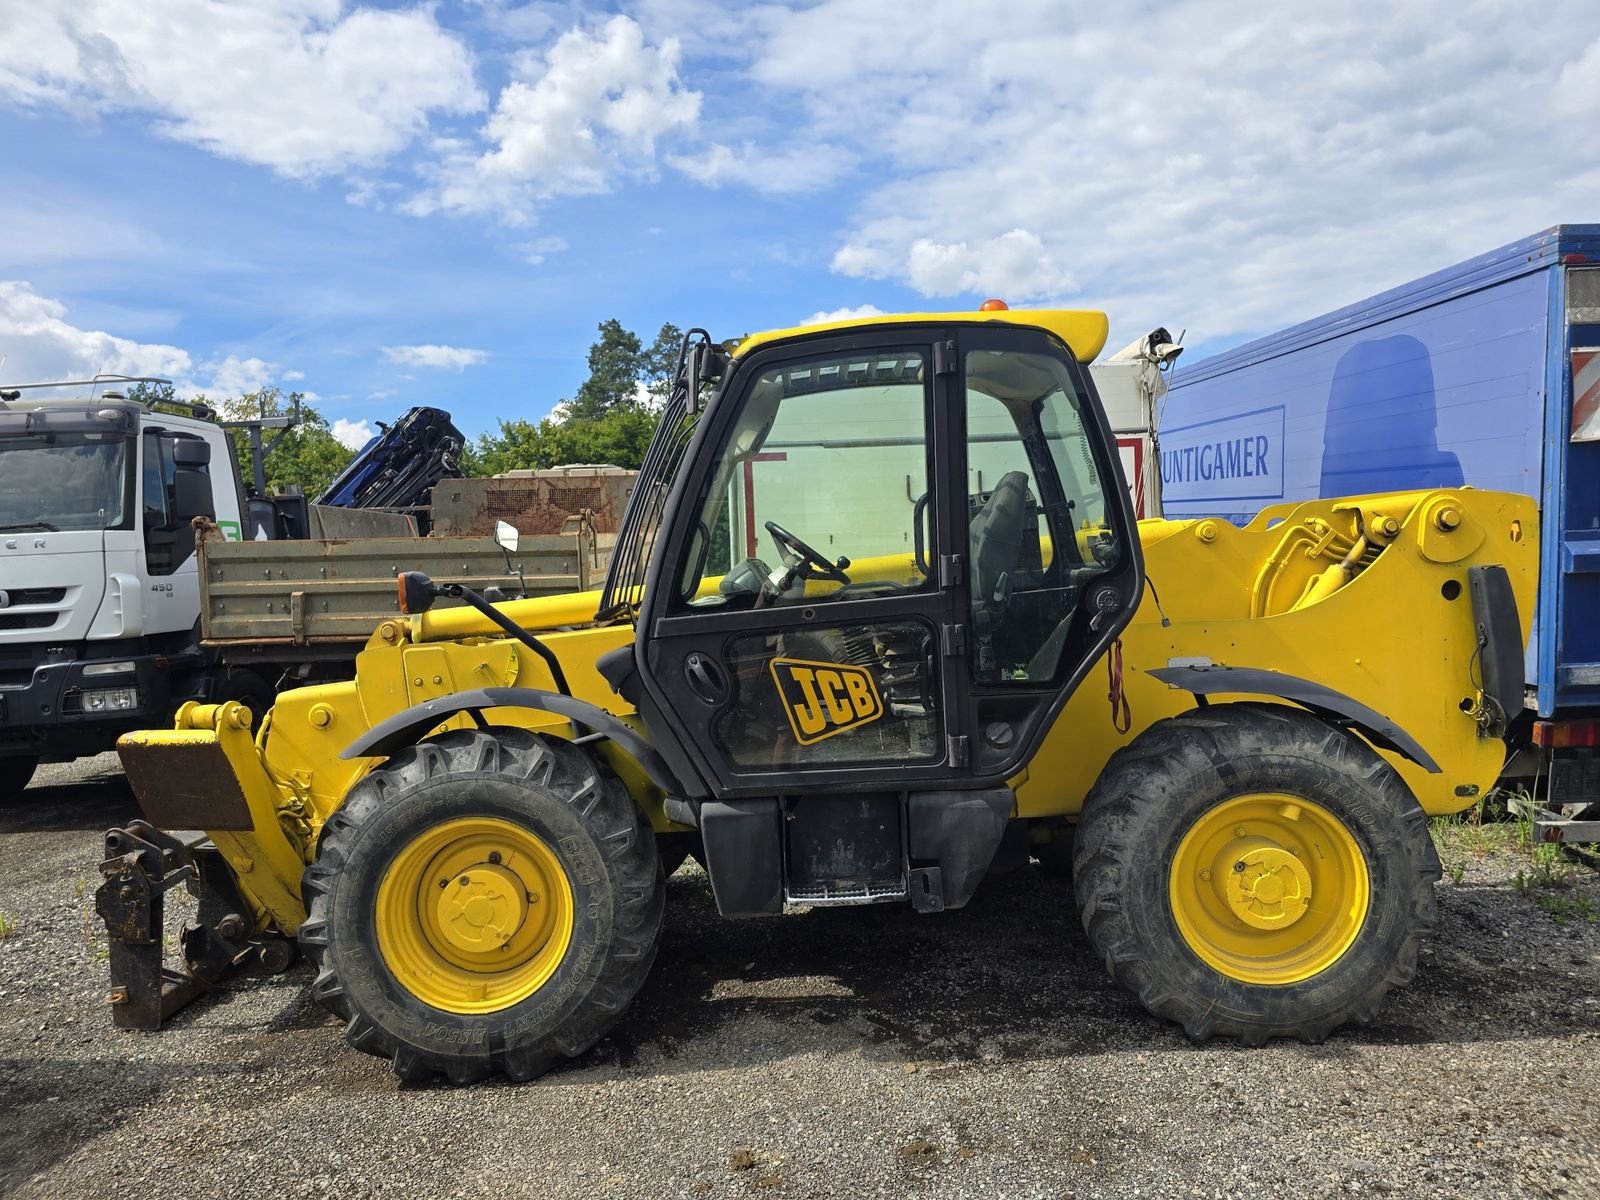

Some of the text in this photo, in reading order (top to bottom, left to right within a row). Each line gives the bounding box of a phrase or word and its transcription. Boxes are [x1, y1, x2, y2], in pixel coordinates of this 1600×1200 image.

[1159, 435, 1269, 484] UNTIGAMER
[151, 583, 173, 592] 450
[790, 667, 875, 735] JCB
